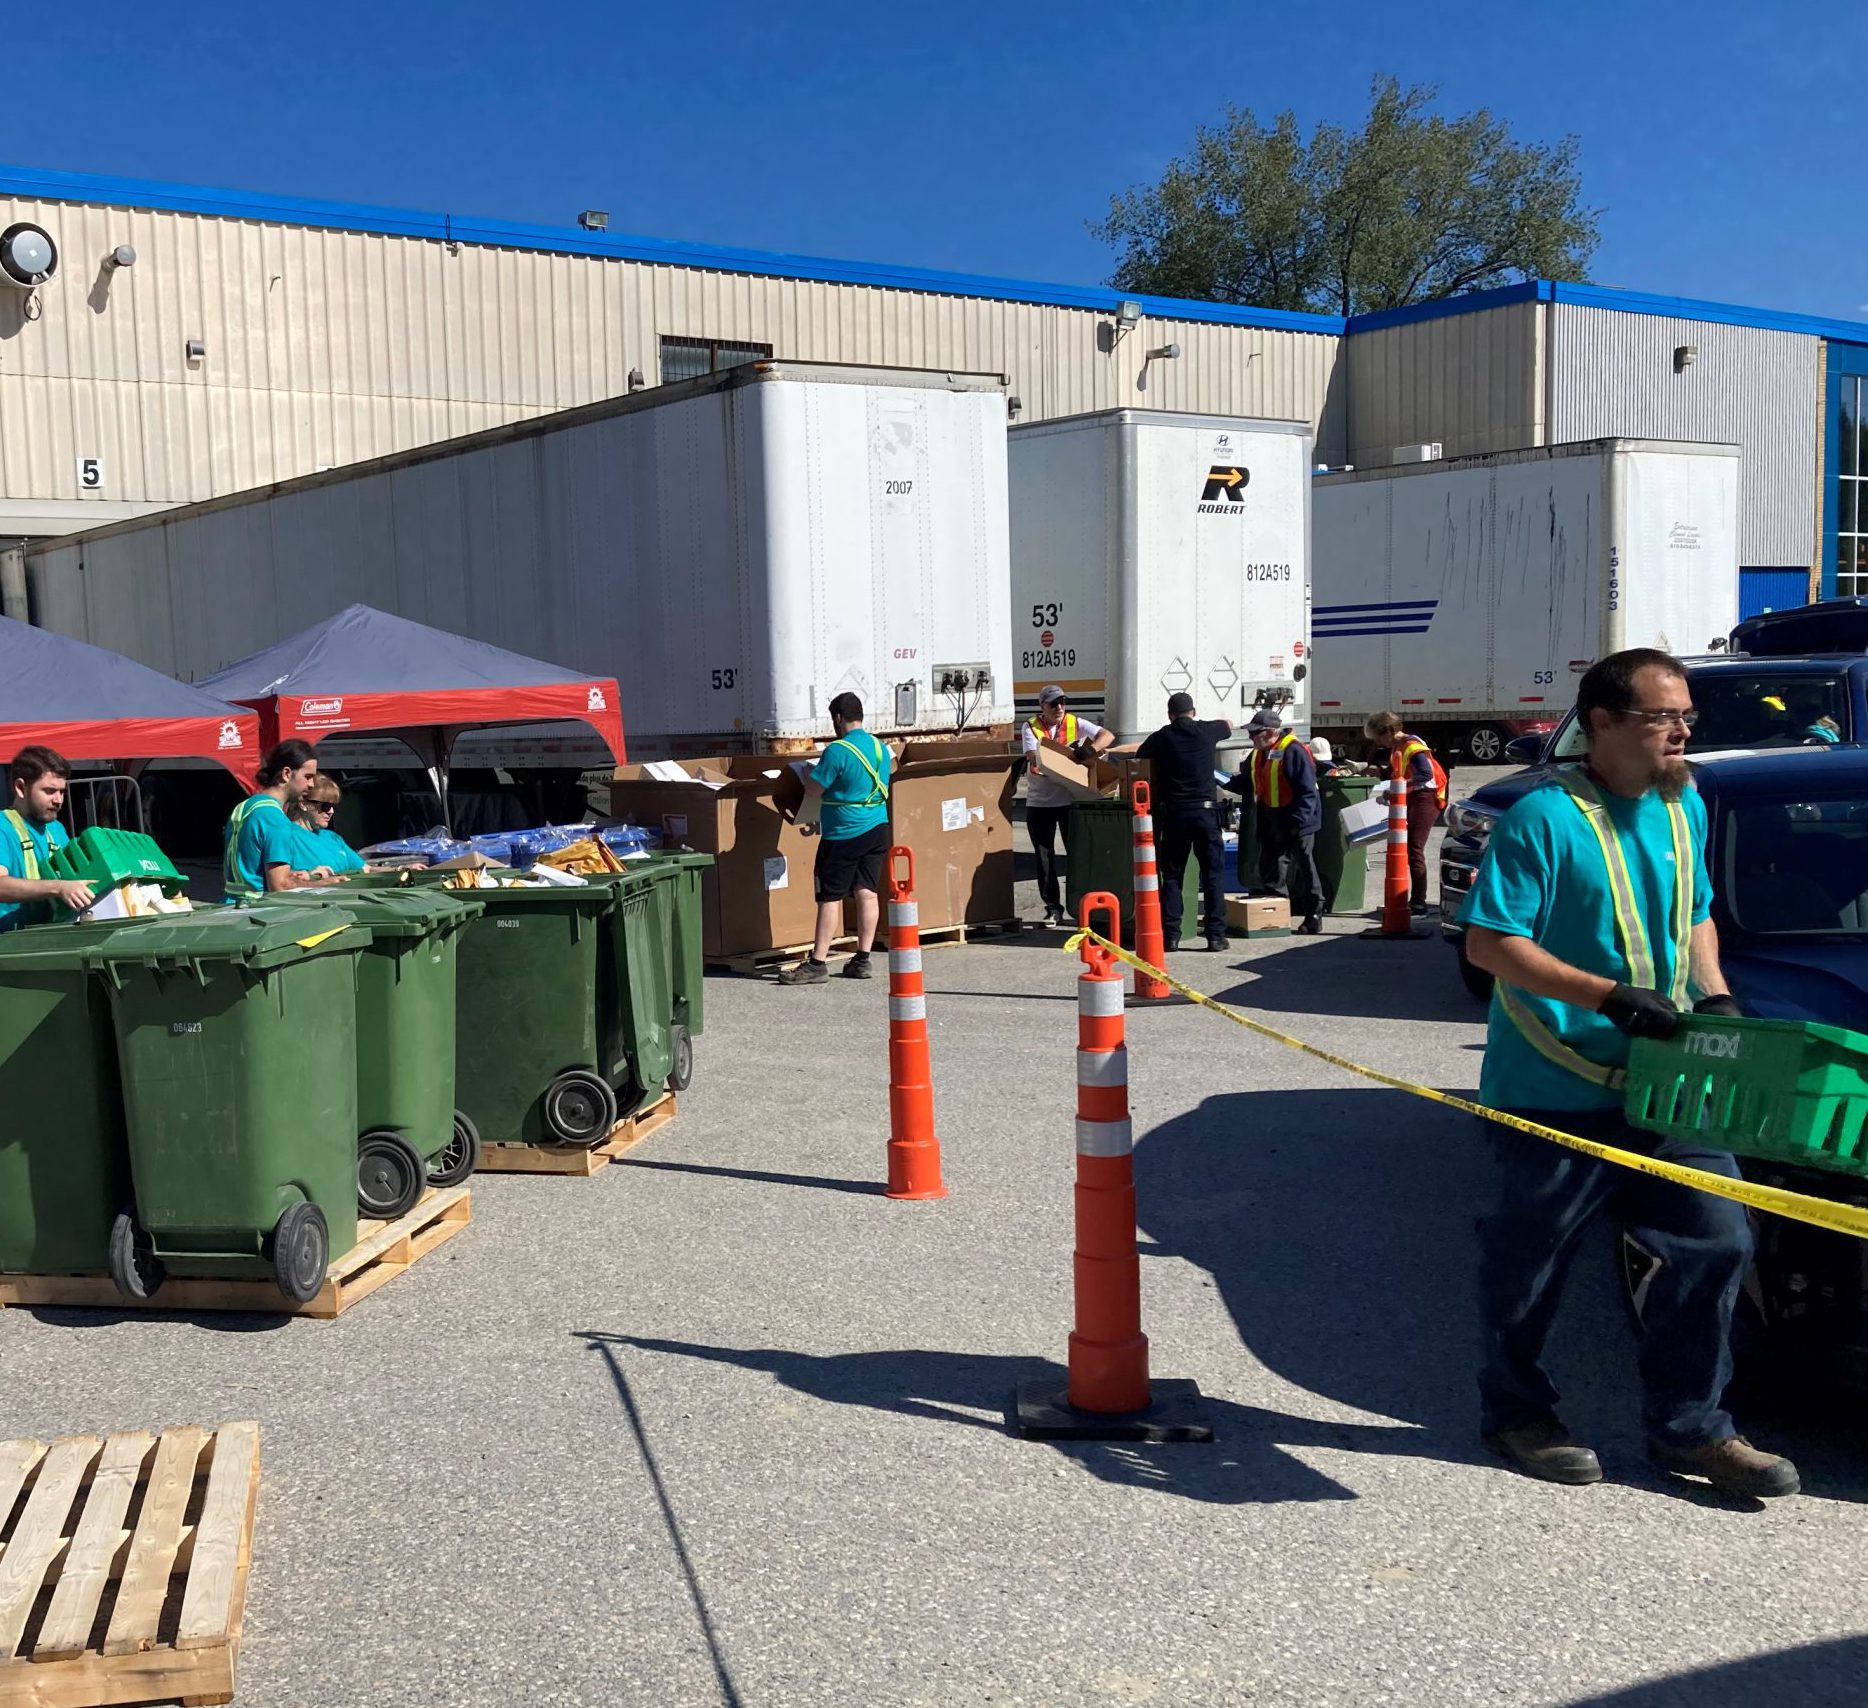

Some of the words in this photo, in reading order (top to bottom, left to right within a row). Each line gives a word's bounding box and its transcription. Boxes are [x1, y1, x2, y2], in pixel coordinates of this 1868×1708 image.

[82, 459, 100, 486] 5
[885, 480, 913, 495] 2007
[1197, 503, 1246, 515] ROBERT
[1247, 563, 1290, 581] 812A519
[1608, 546, 1619, 611] 151603
[1032, 602, 1063, 628] 53'
[893, 648, 917, 660] GEV
[1022, 648, 1076, 669] 812A519
[711, 667, 738, 690] 53'
[304, 701, 334, 712] Coleman
